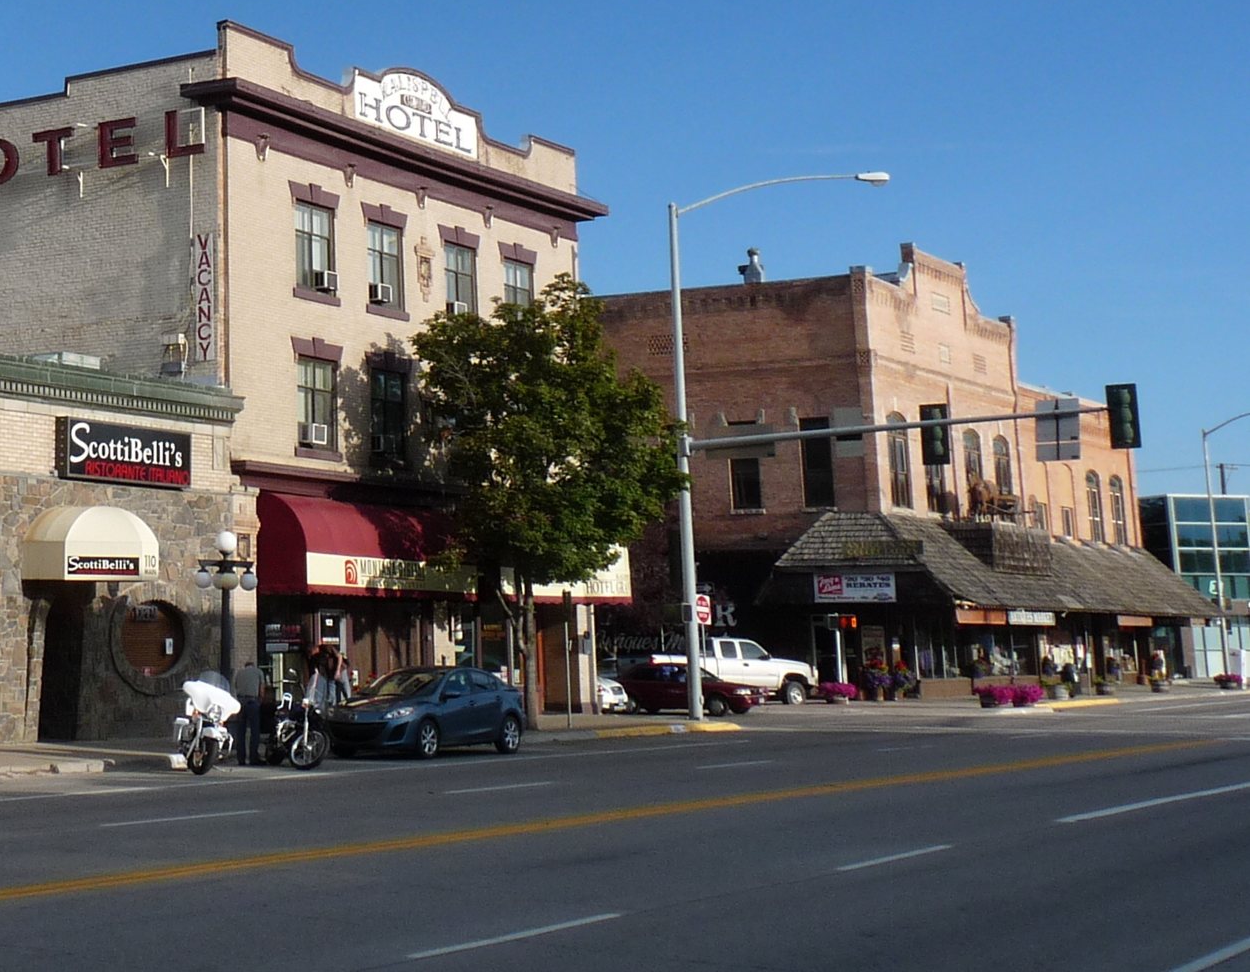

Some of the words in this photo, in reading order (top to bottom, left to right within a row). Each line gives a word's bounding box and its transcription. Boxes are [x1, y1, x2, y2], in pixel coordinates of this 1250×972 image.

[358, 91, 472, 154] HOTEL
[196, 232, 212, 362] VACANCY
[70, 422, 183, 467] ScottiBelli's
[84, 460, 147, 481] RISTORANTE
[150, 466, 190, 485] ITALIANO
[68, 556, 135, 571] ScottiBelli's
[144, 555, 157, 568] 110
[845, 581, 891, 589] REBATES
